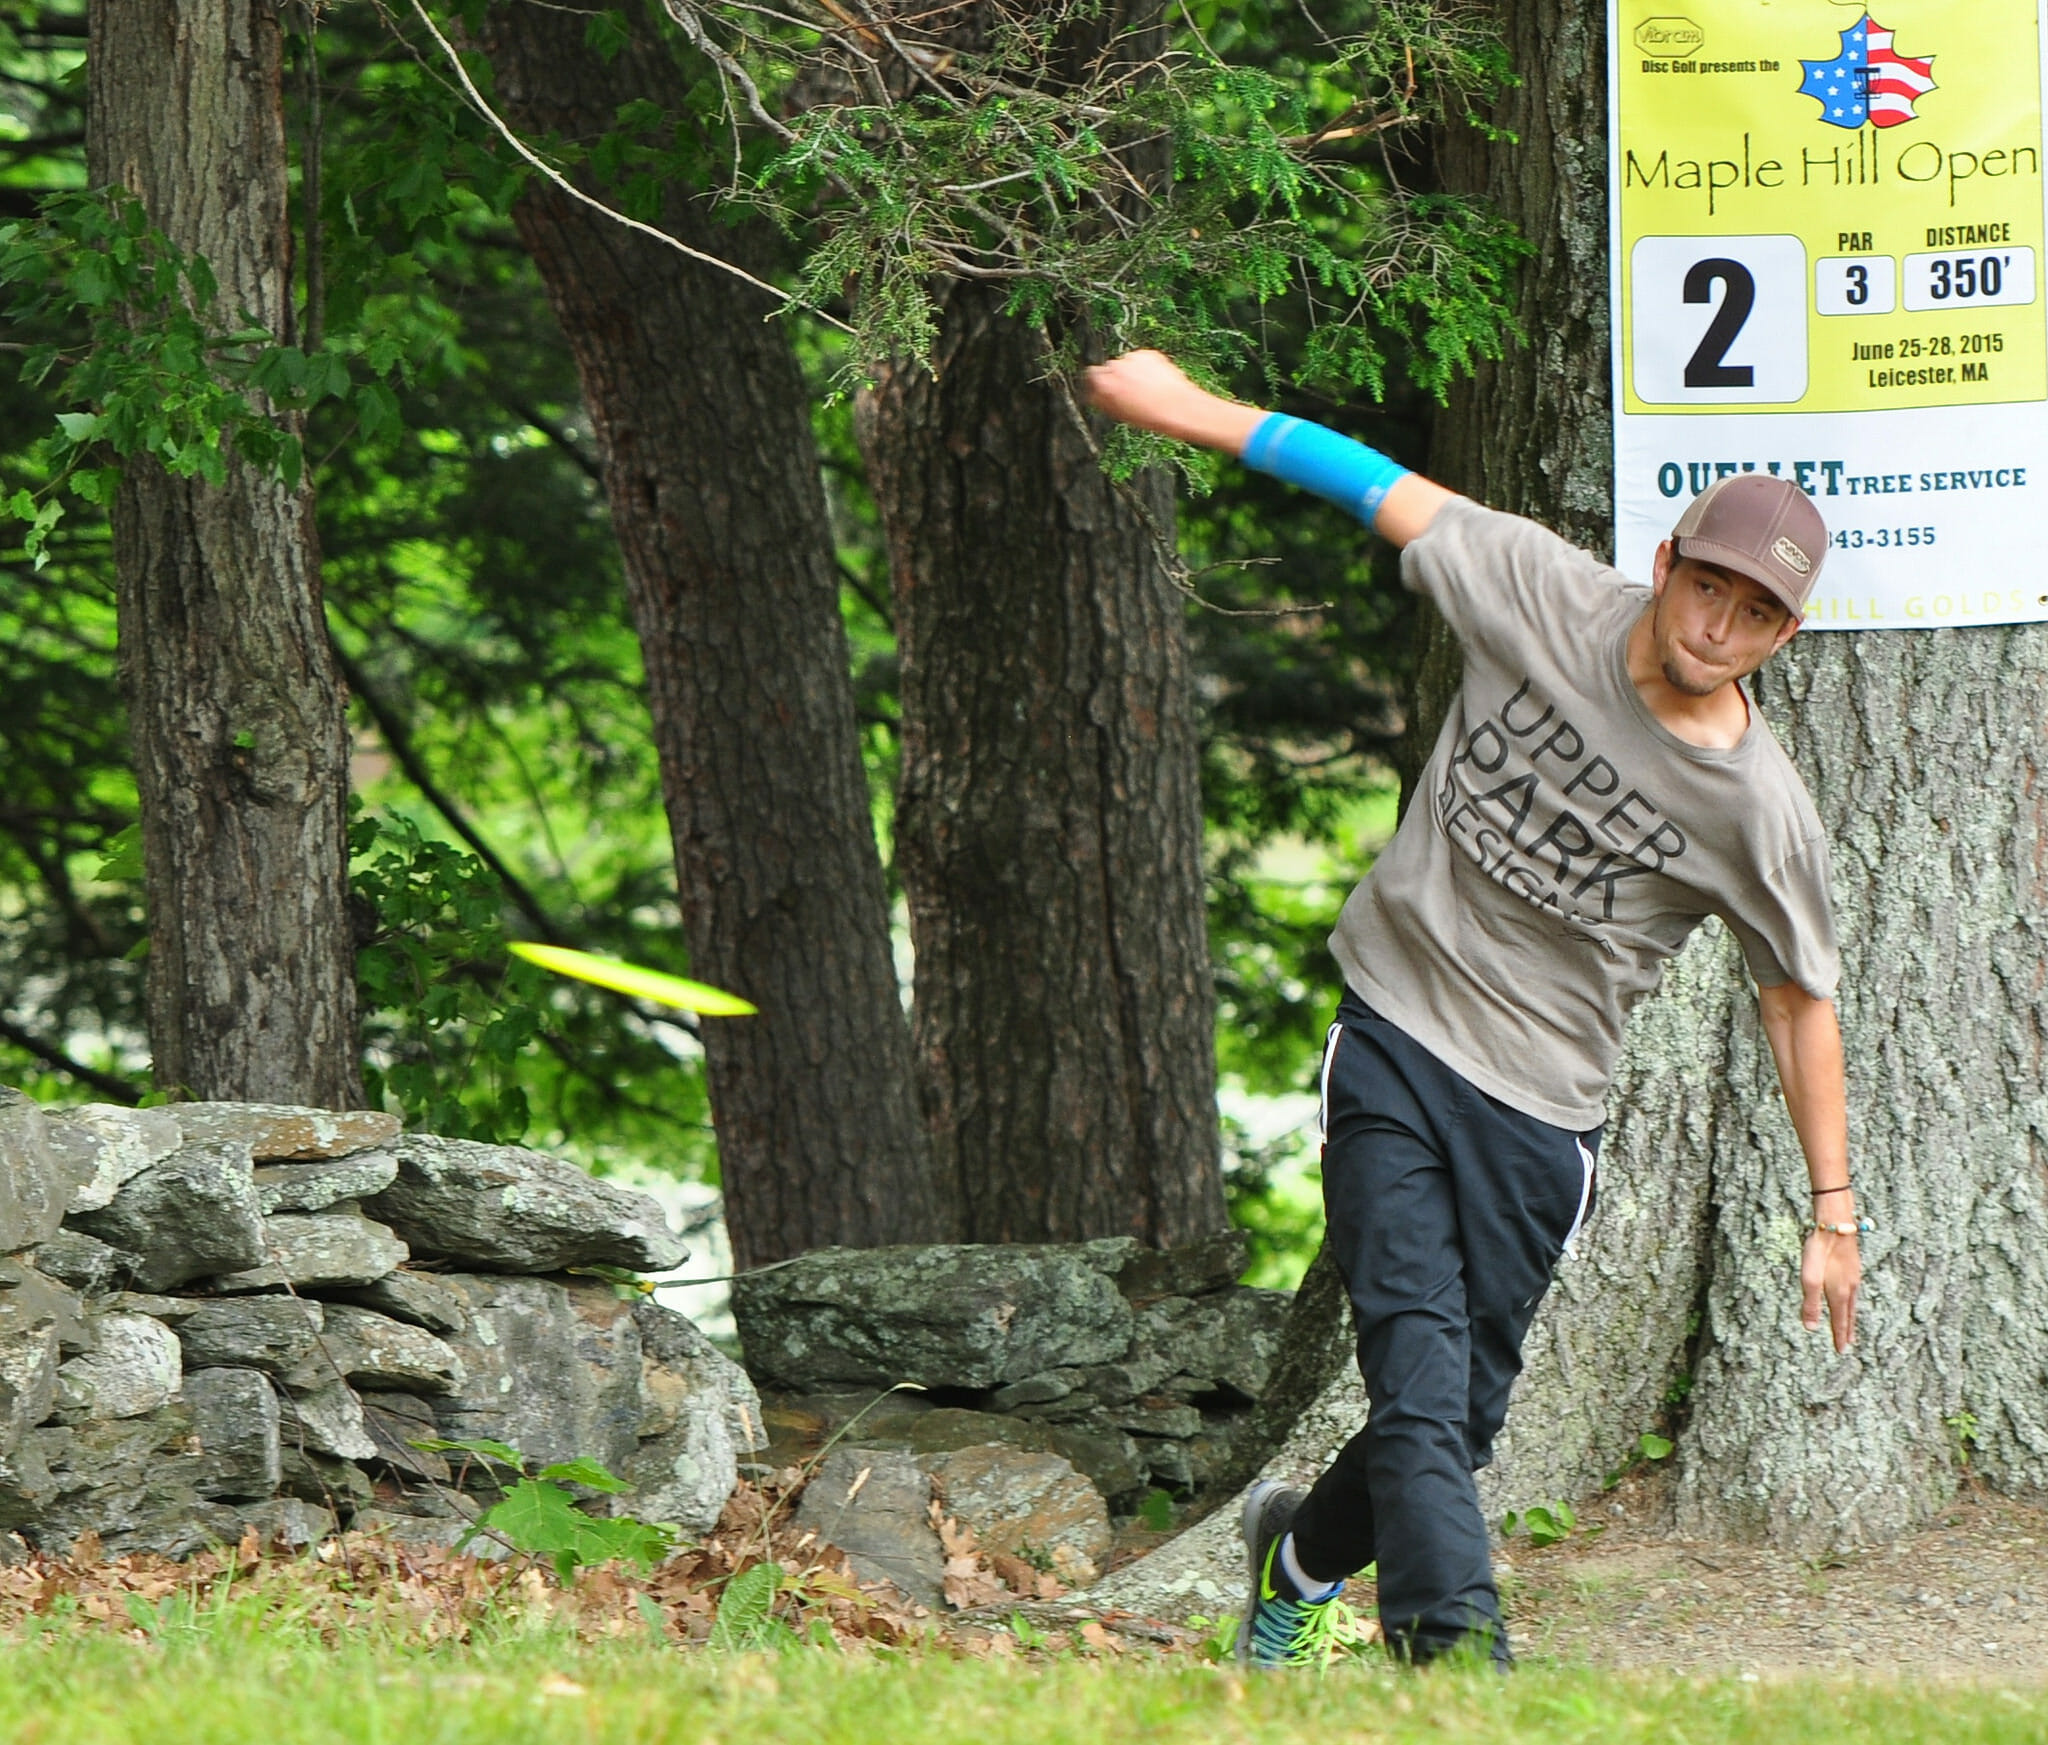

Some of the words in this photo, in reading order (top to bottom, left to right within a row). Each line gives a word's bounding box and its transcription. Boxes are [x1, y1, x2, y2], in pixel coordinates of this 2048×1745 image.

[1641, 60, 1669, 73] Disc
[1671, 60, 1697, 73] Golf
[1699, 60, 1756, 74] presents
[1759, 59, 1780, 72] the
[1626, 132, 1784, 215] Maple
[1803, 129, 1880, 186] Hill
[1897, 141, 2038, 207] Open
[1838, 231, 1873, 251] PAR
[1926, 223, 2011, 247] DISTANCE
[1682, 257, 1756, 388] 2
[1846, 265, 1868, 305] 3
[1930, 256, 2011, 299] 350'
[1852, 341, 1894, 361] June
[1899, 336, 1956, 358] 25-28,
[1960, 333, 2003, 354] 2015
[1869, 366, 1957, 387] Leicester,
[1961, 362, 1989, 382] MA
[1657, 461, 1844, 498] OUET
[1846, 474, 1912, 496] TREE
[1920, 468, 2027, 491] SERVICE
[1828, 526, 1936, 549] 43-3155
[1802, 597, 1884, 620] HILL
[1904, 589, 2025, 618] GOLDS
[1500, 676, 1686, 873] UPPER
[1453, 720, 1656, 920] PARK
[1438, 775, 1601, 926] DESIG
